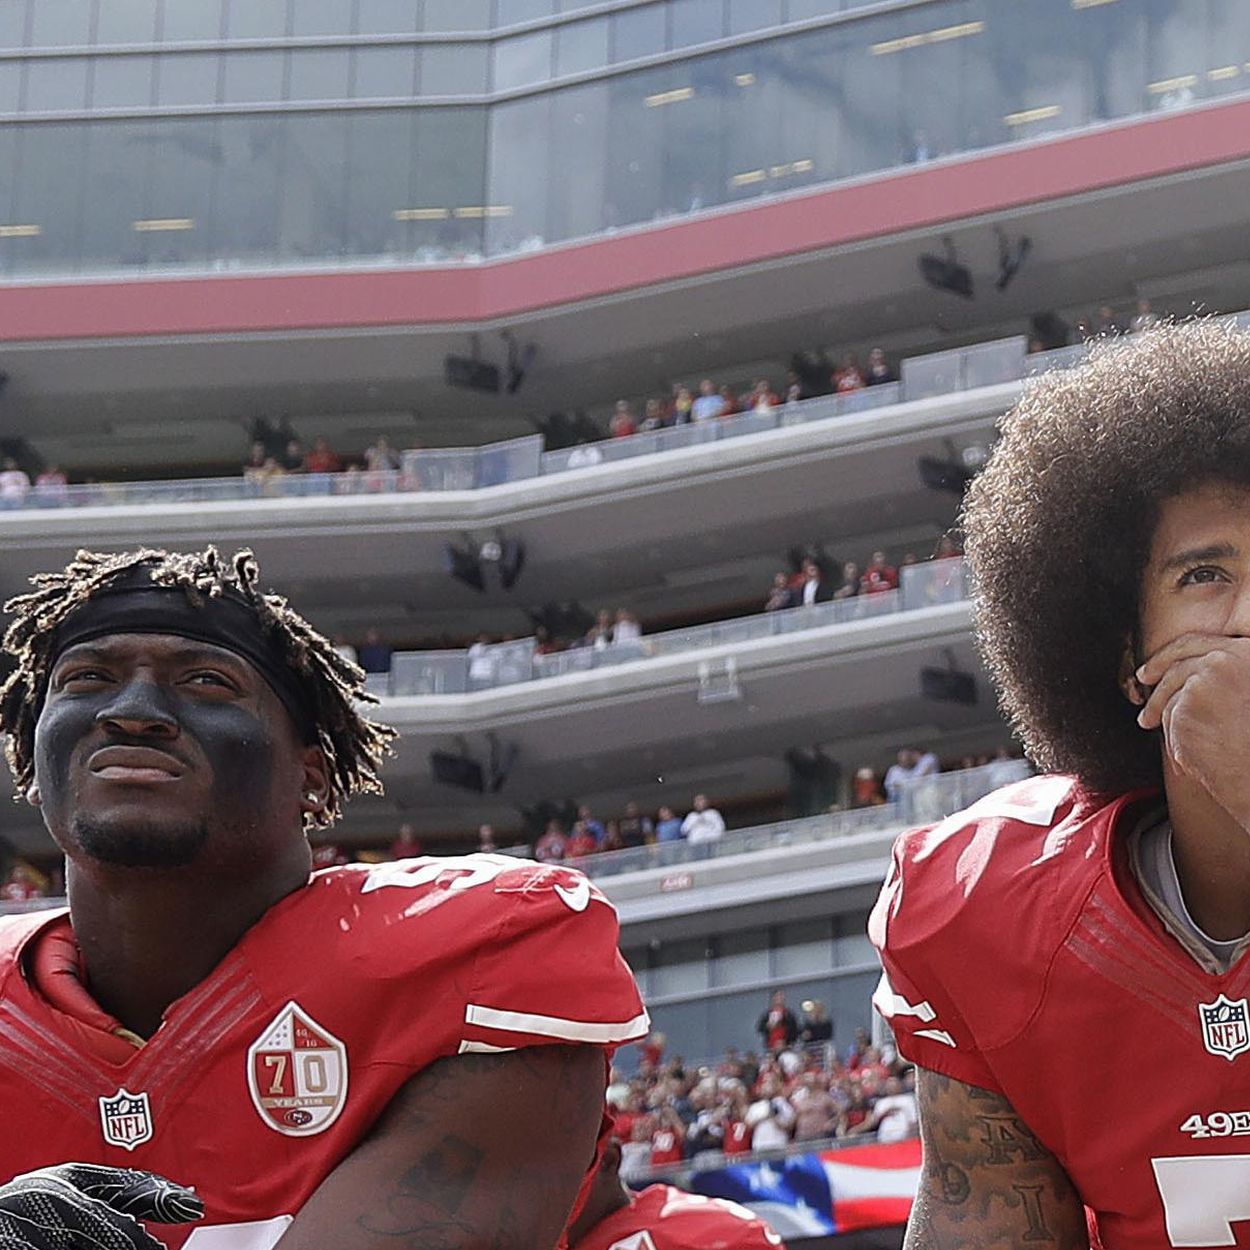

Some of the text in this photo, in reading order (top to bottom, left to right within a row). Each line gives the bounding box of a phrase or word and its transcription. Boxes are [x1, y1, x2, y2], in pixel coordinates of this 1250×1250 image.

[1210, 1022, 1246, 1049] NFL
[265, 1055, 328, 1093] 70
[109, 1115, 145, 1140] NFL
